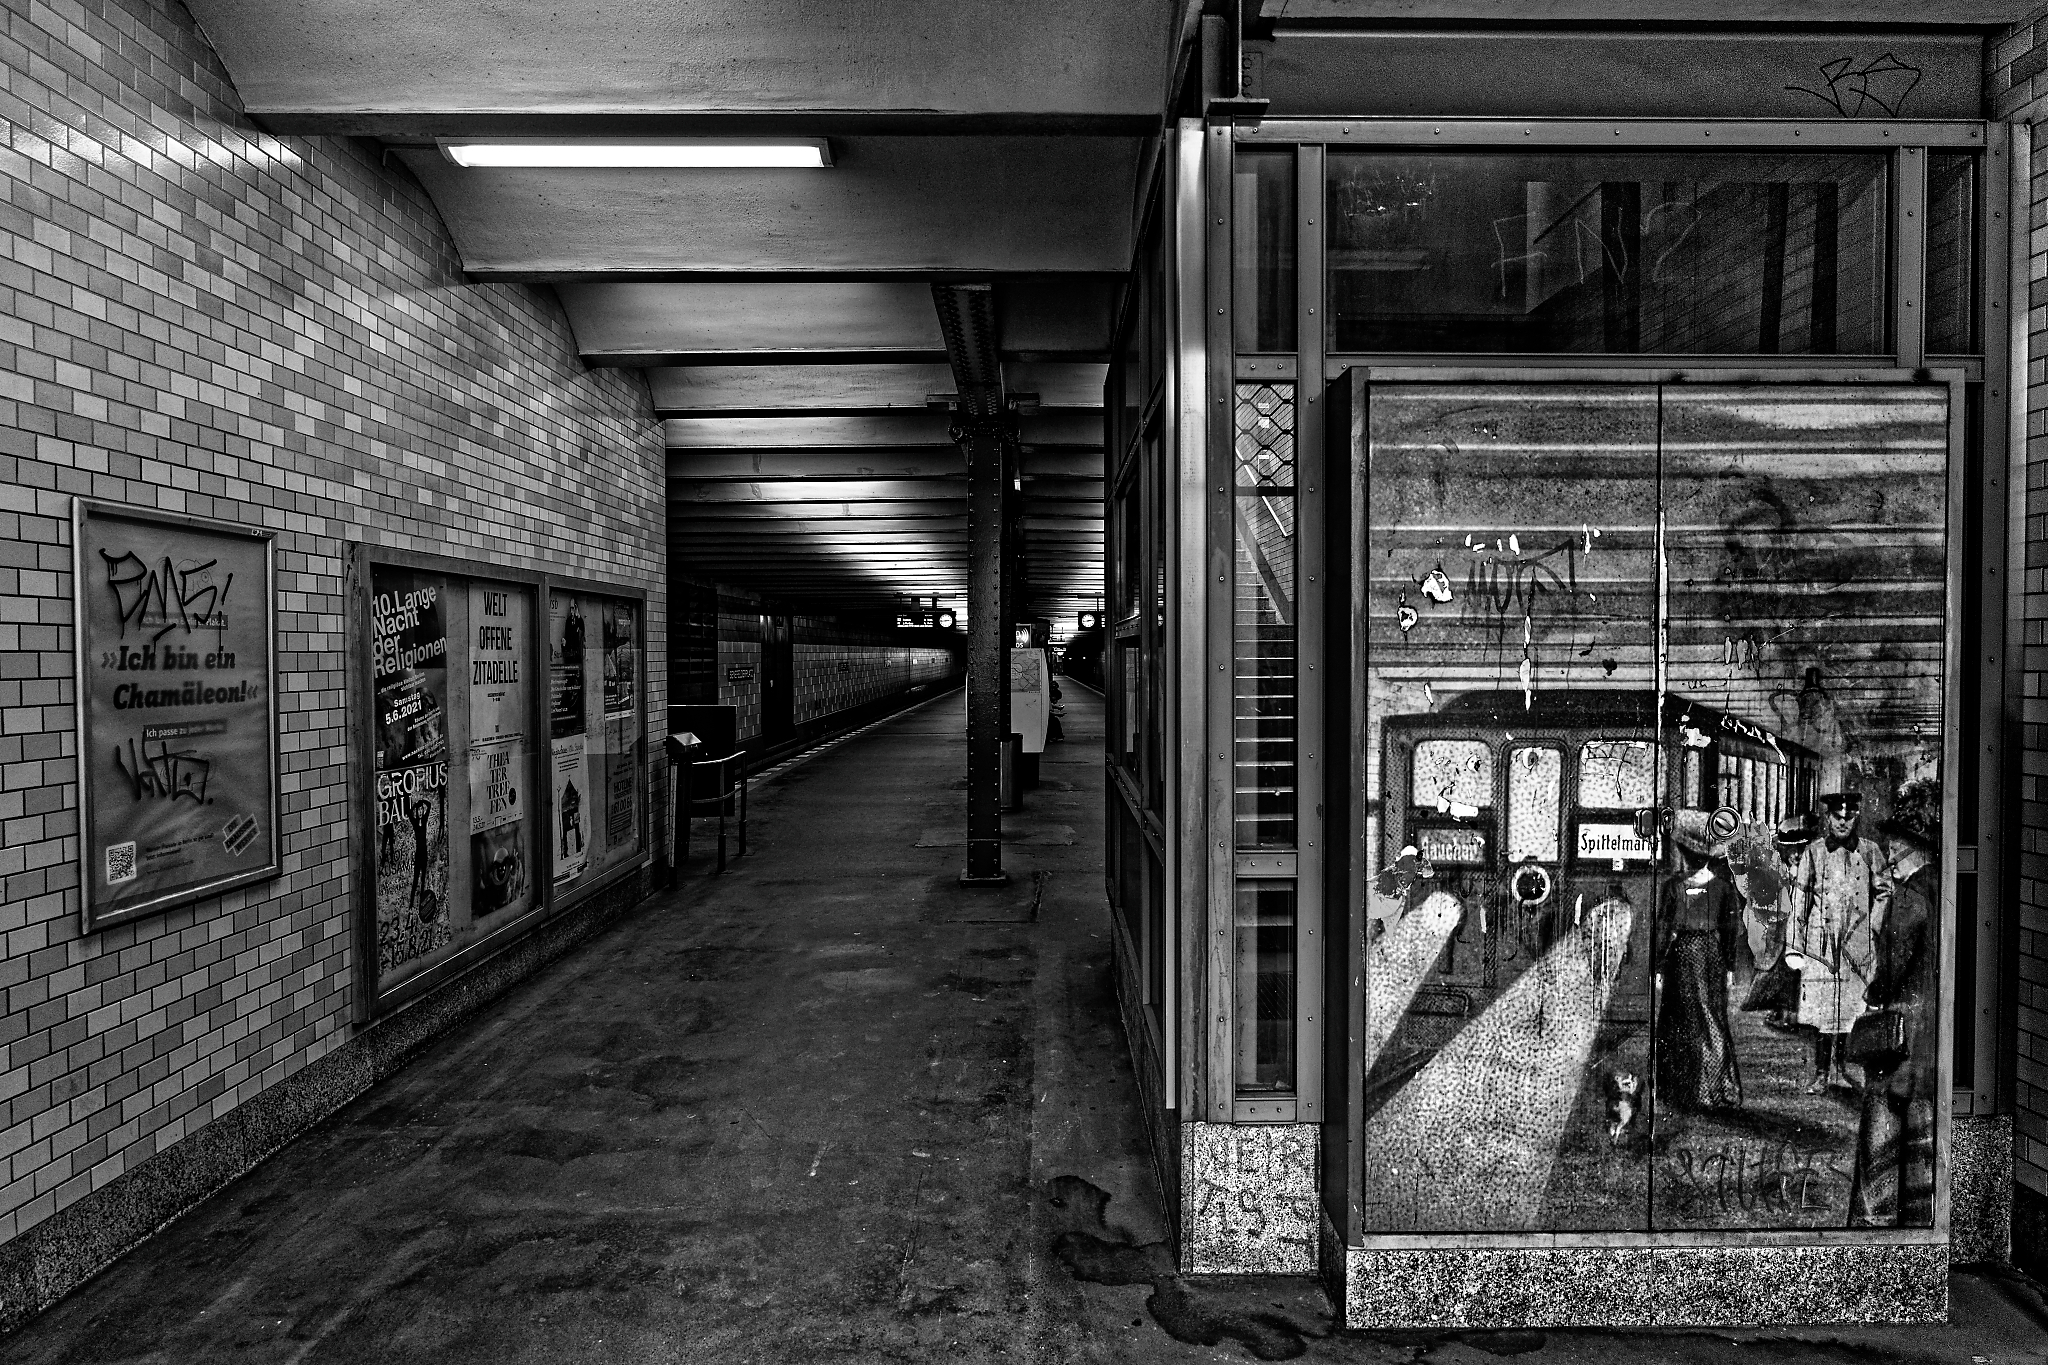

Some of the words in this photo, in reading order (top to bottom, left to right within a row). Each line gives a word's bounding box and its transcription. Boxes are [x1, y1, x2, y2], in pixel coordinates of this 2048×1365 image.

[483, 591, 508, 616] WELT
[373, 606, 420, 638] Nacht
[373, 634, 400, 656] der
[479, 625, 512, 650] OFFENE
[163, 645, 198, 670] bin
[205, 645, 236, 669] ein
[373, 637, 446, 678] Religionen
[473, 660, 519, 685] ZITADELLE
[393, 692, 421, 707] Samstag
[385, 700, 422, 725] 5.6.2021
[146, 729, 157, 738] Ich
[159, 728, 178, 739] passe
[487, 751, 510, 769] THEA
[377, 763, 448, 799] GROPIUS
[490, 767, 508, 784] TER
[379, 795, 412, 826] BAU
